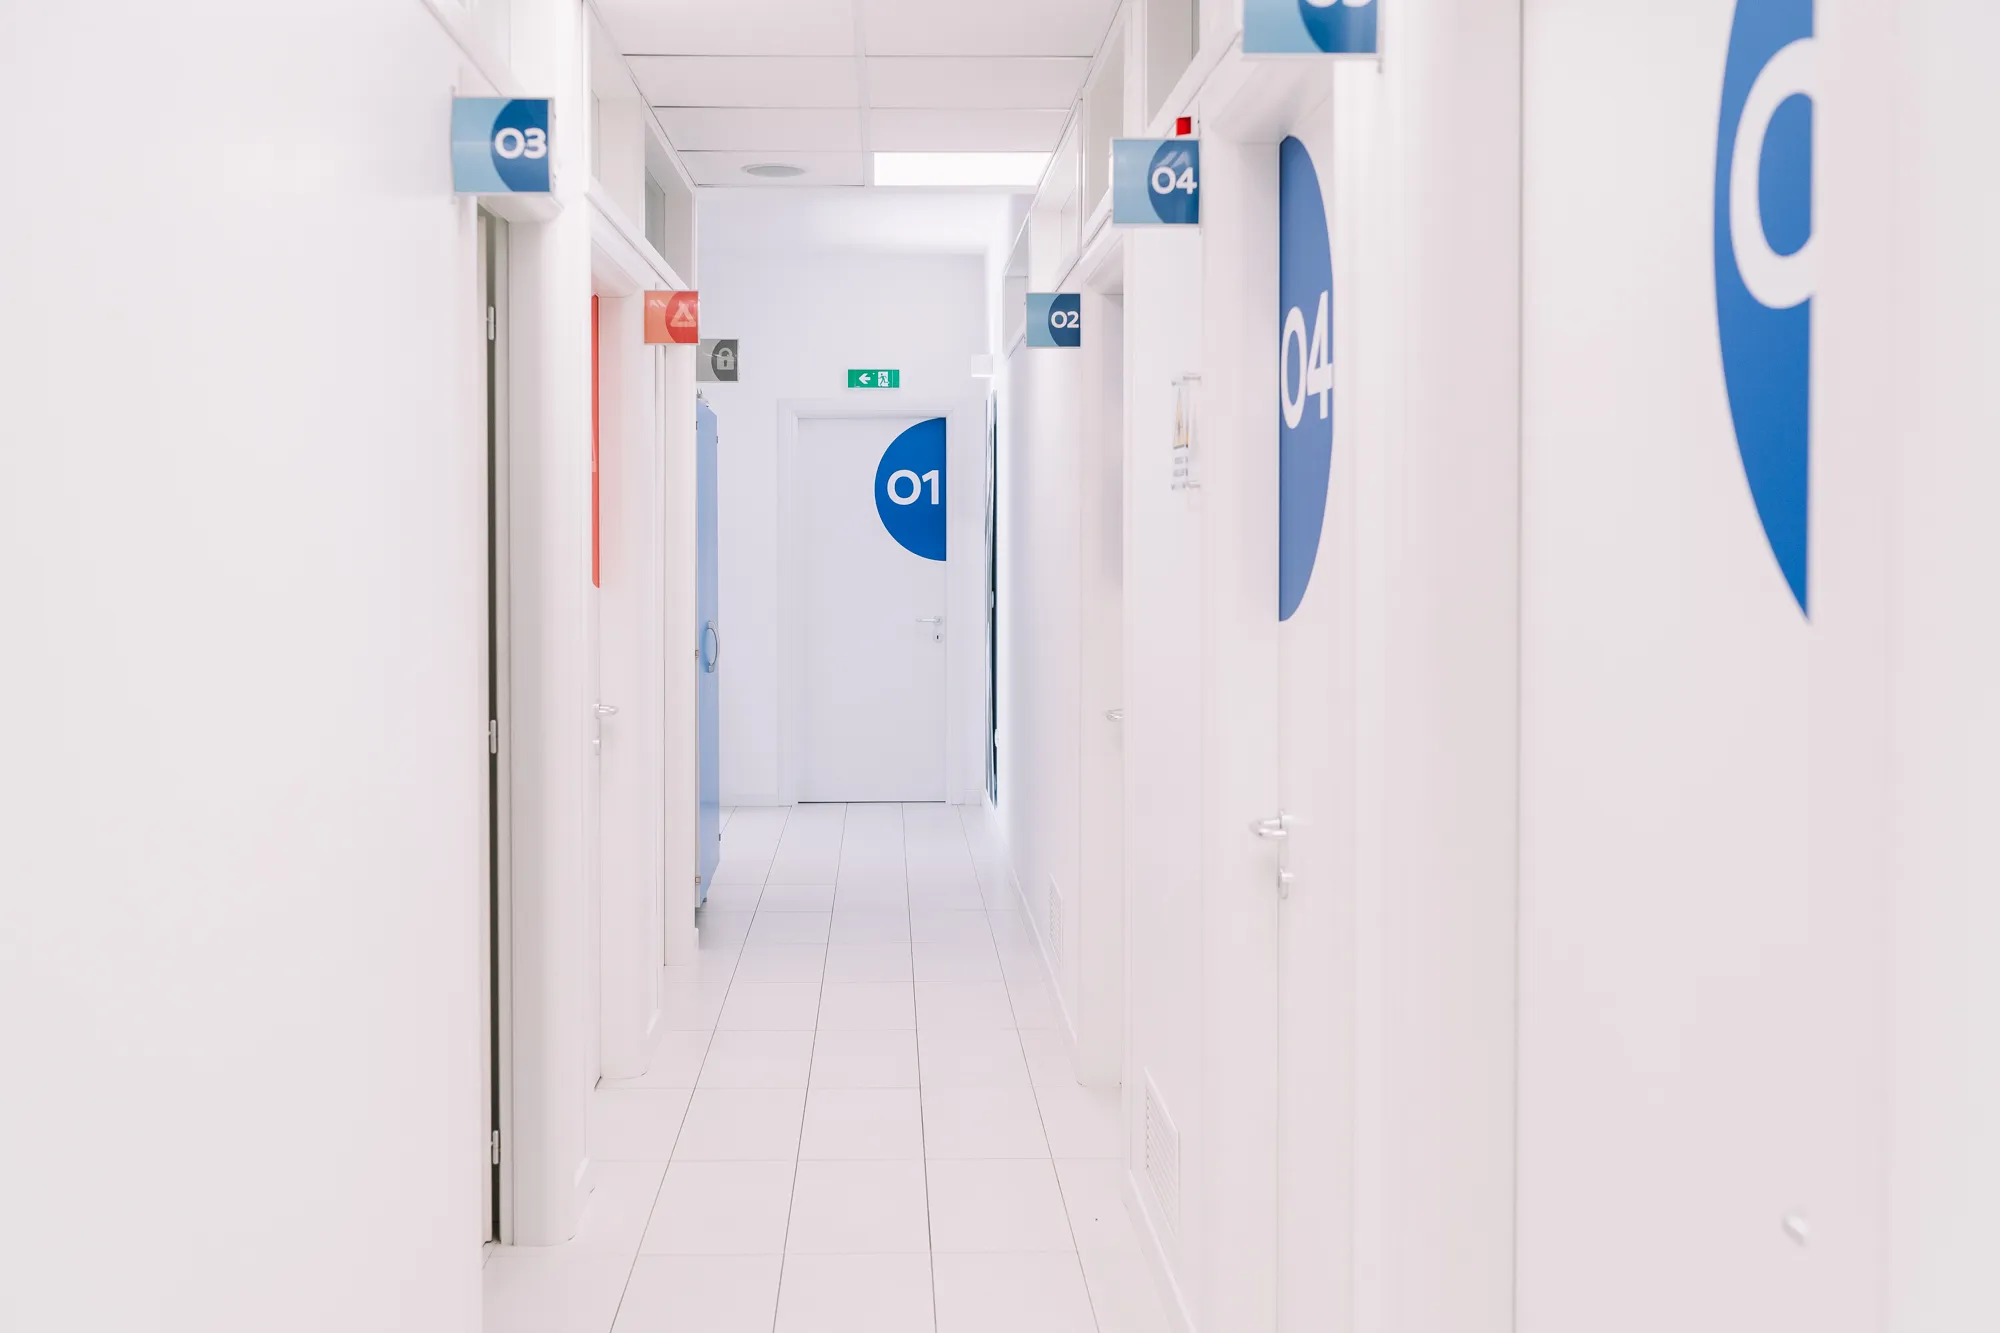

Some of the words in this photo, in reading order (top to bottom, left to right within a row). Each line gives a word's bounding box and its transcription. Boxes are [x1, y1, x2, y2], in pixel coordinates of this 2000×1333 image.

[494, 127, 547, 159] 03
[1151, 166, 1197, 194] 04
[1051, 310, 1079, 328] 02
[1280, 290, 1333, 429] 04
[886, 469, 940, 505] 01
